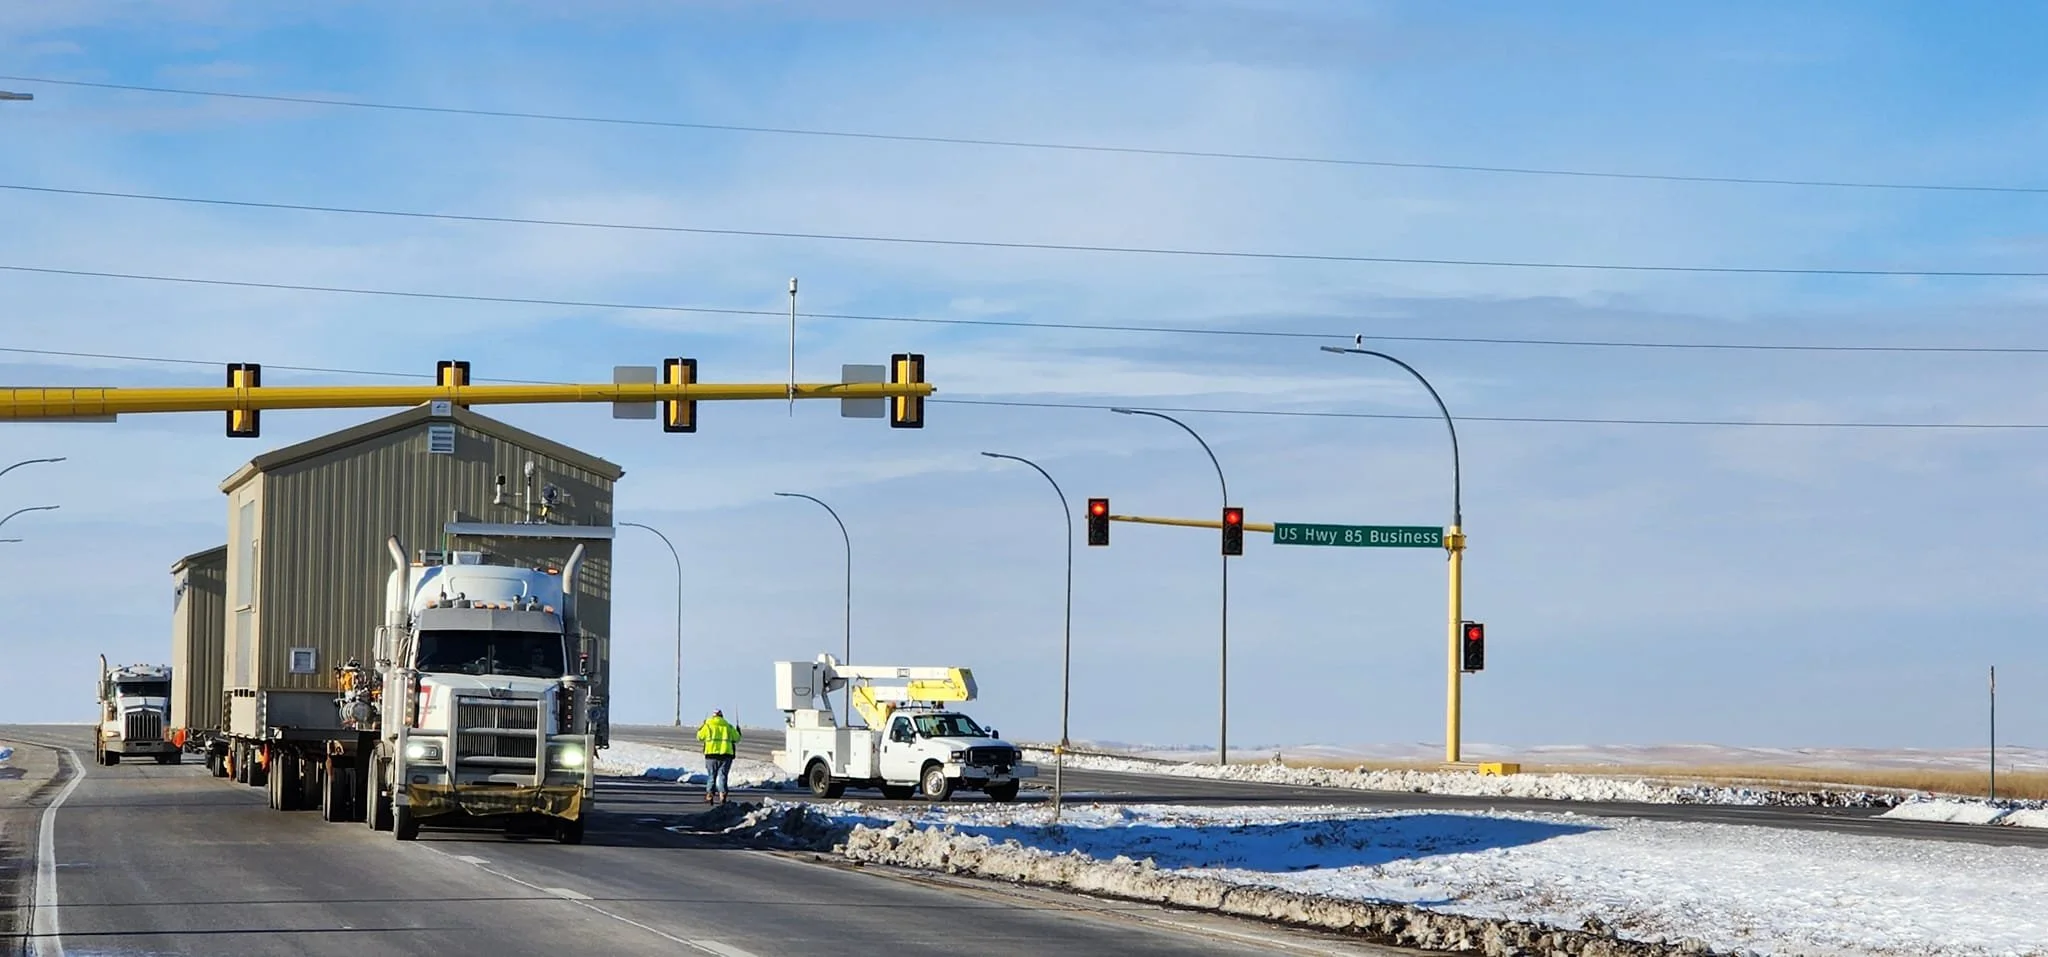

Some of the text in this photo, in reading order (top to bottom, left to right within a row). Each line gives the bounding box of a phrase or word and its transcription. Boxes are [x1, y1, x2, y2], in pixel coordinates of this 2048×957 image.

[1278, 527, 1439, 544] US Hwy 85 Business
